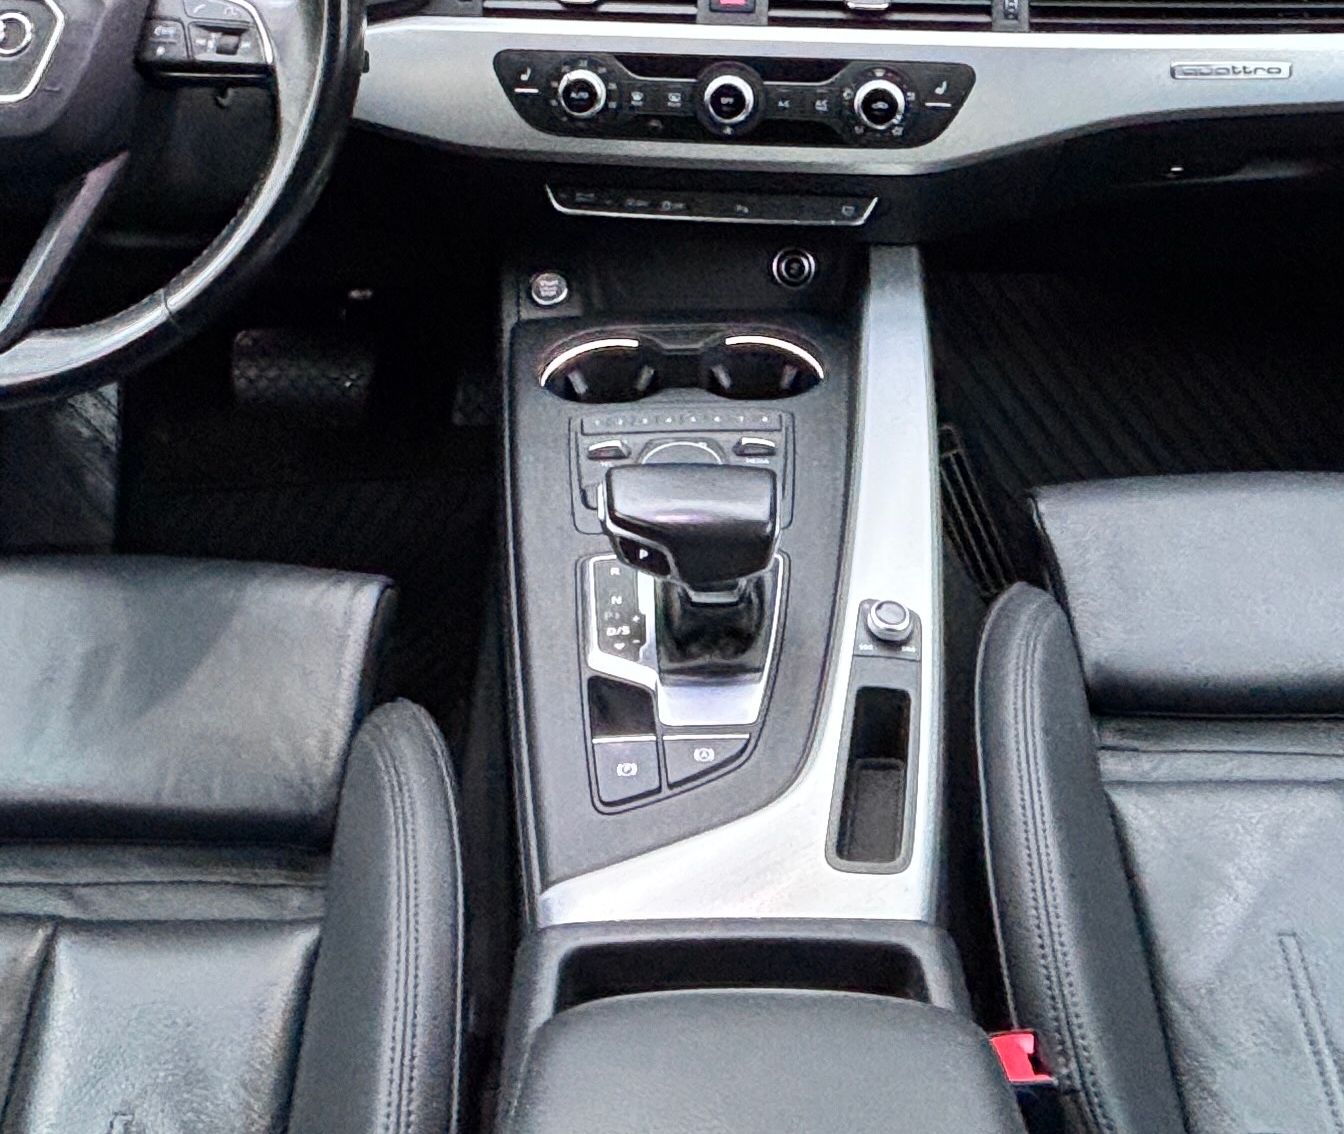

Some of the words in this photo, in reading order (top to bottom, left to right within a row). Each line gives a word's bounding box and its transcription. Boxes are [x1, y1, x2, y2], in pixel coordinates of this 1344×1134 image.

[1182, 65, 1282, 76] quattro
[639, 548, 649, 560] P
[610, 567, 621, 576] R
[611, 595, 623, 605] N
[606, 625, 631, 637] D/S
